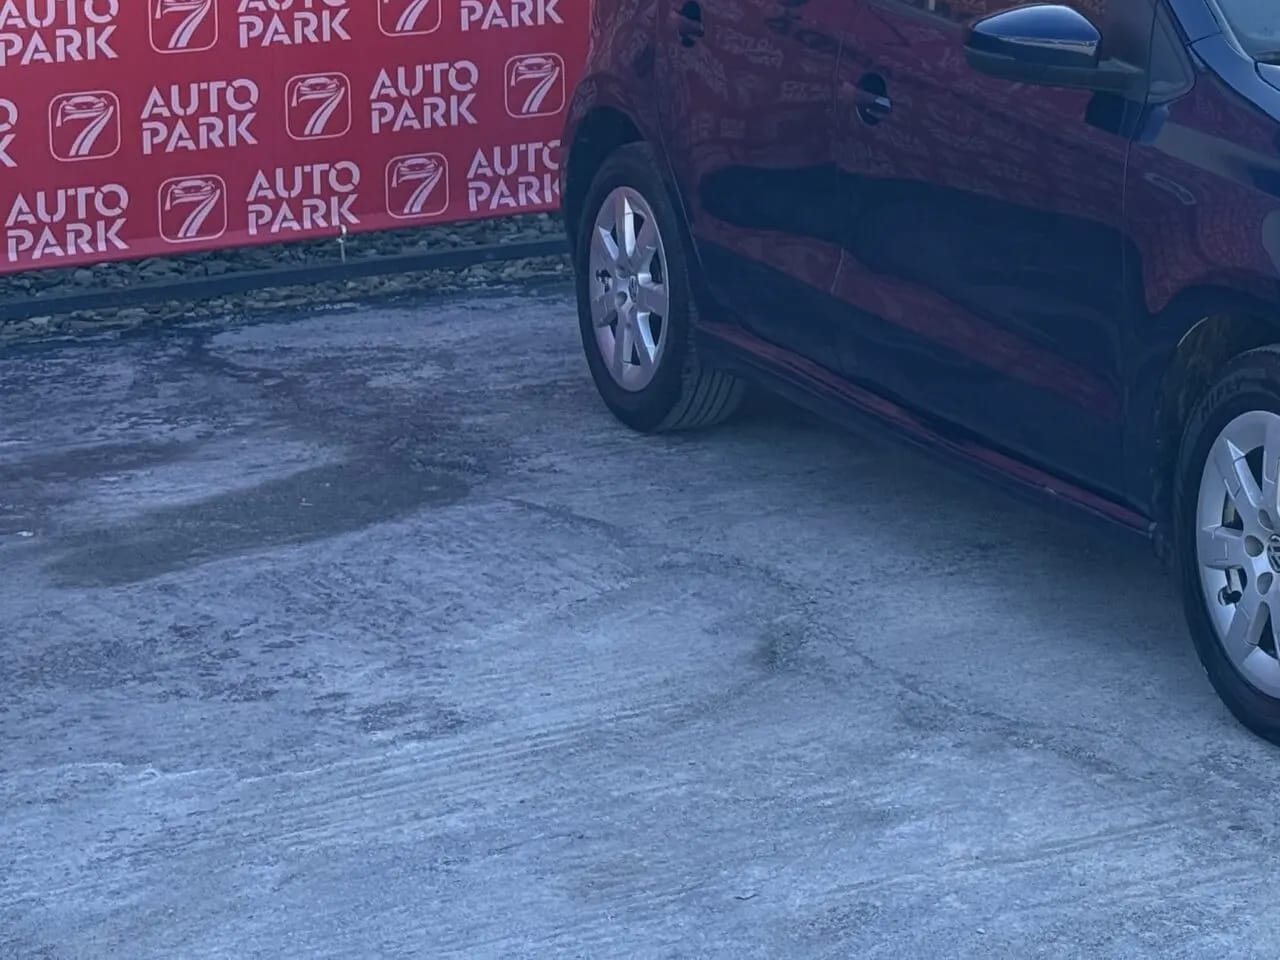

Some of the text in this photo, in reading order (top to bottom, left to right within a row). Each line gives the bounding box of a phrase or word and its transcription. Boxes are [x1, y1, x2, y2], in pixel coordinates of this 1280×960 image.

[0, 25, 117, 66] PARK
[239, 8, 351, 48] PARK
[141, 79, 258, 119] AUTO
[370, 61, 478, 99] AUTO
[372, 93, 477, 133] PARK
[143, 113, 257, 154] PARK
[247, 161, 360, 201] AUTO
[5, 184, 128, 226] AUTO
[248, 194, 360, 237] PARK
[8, 218, 129, 266] PARK
